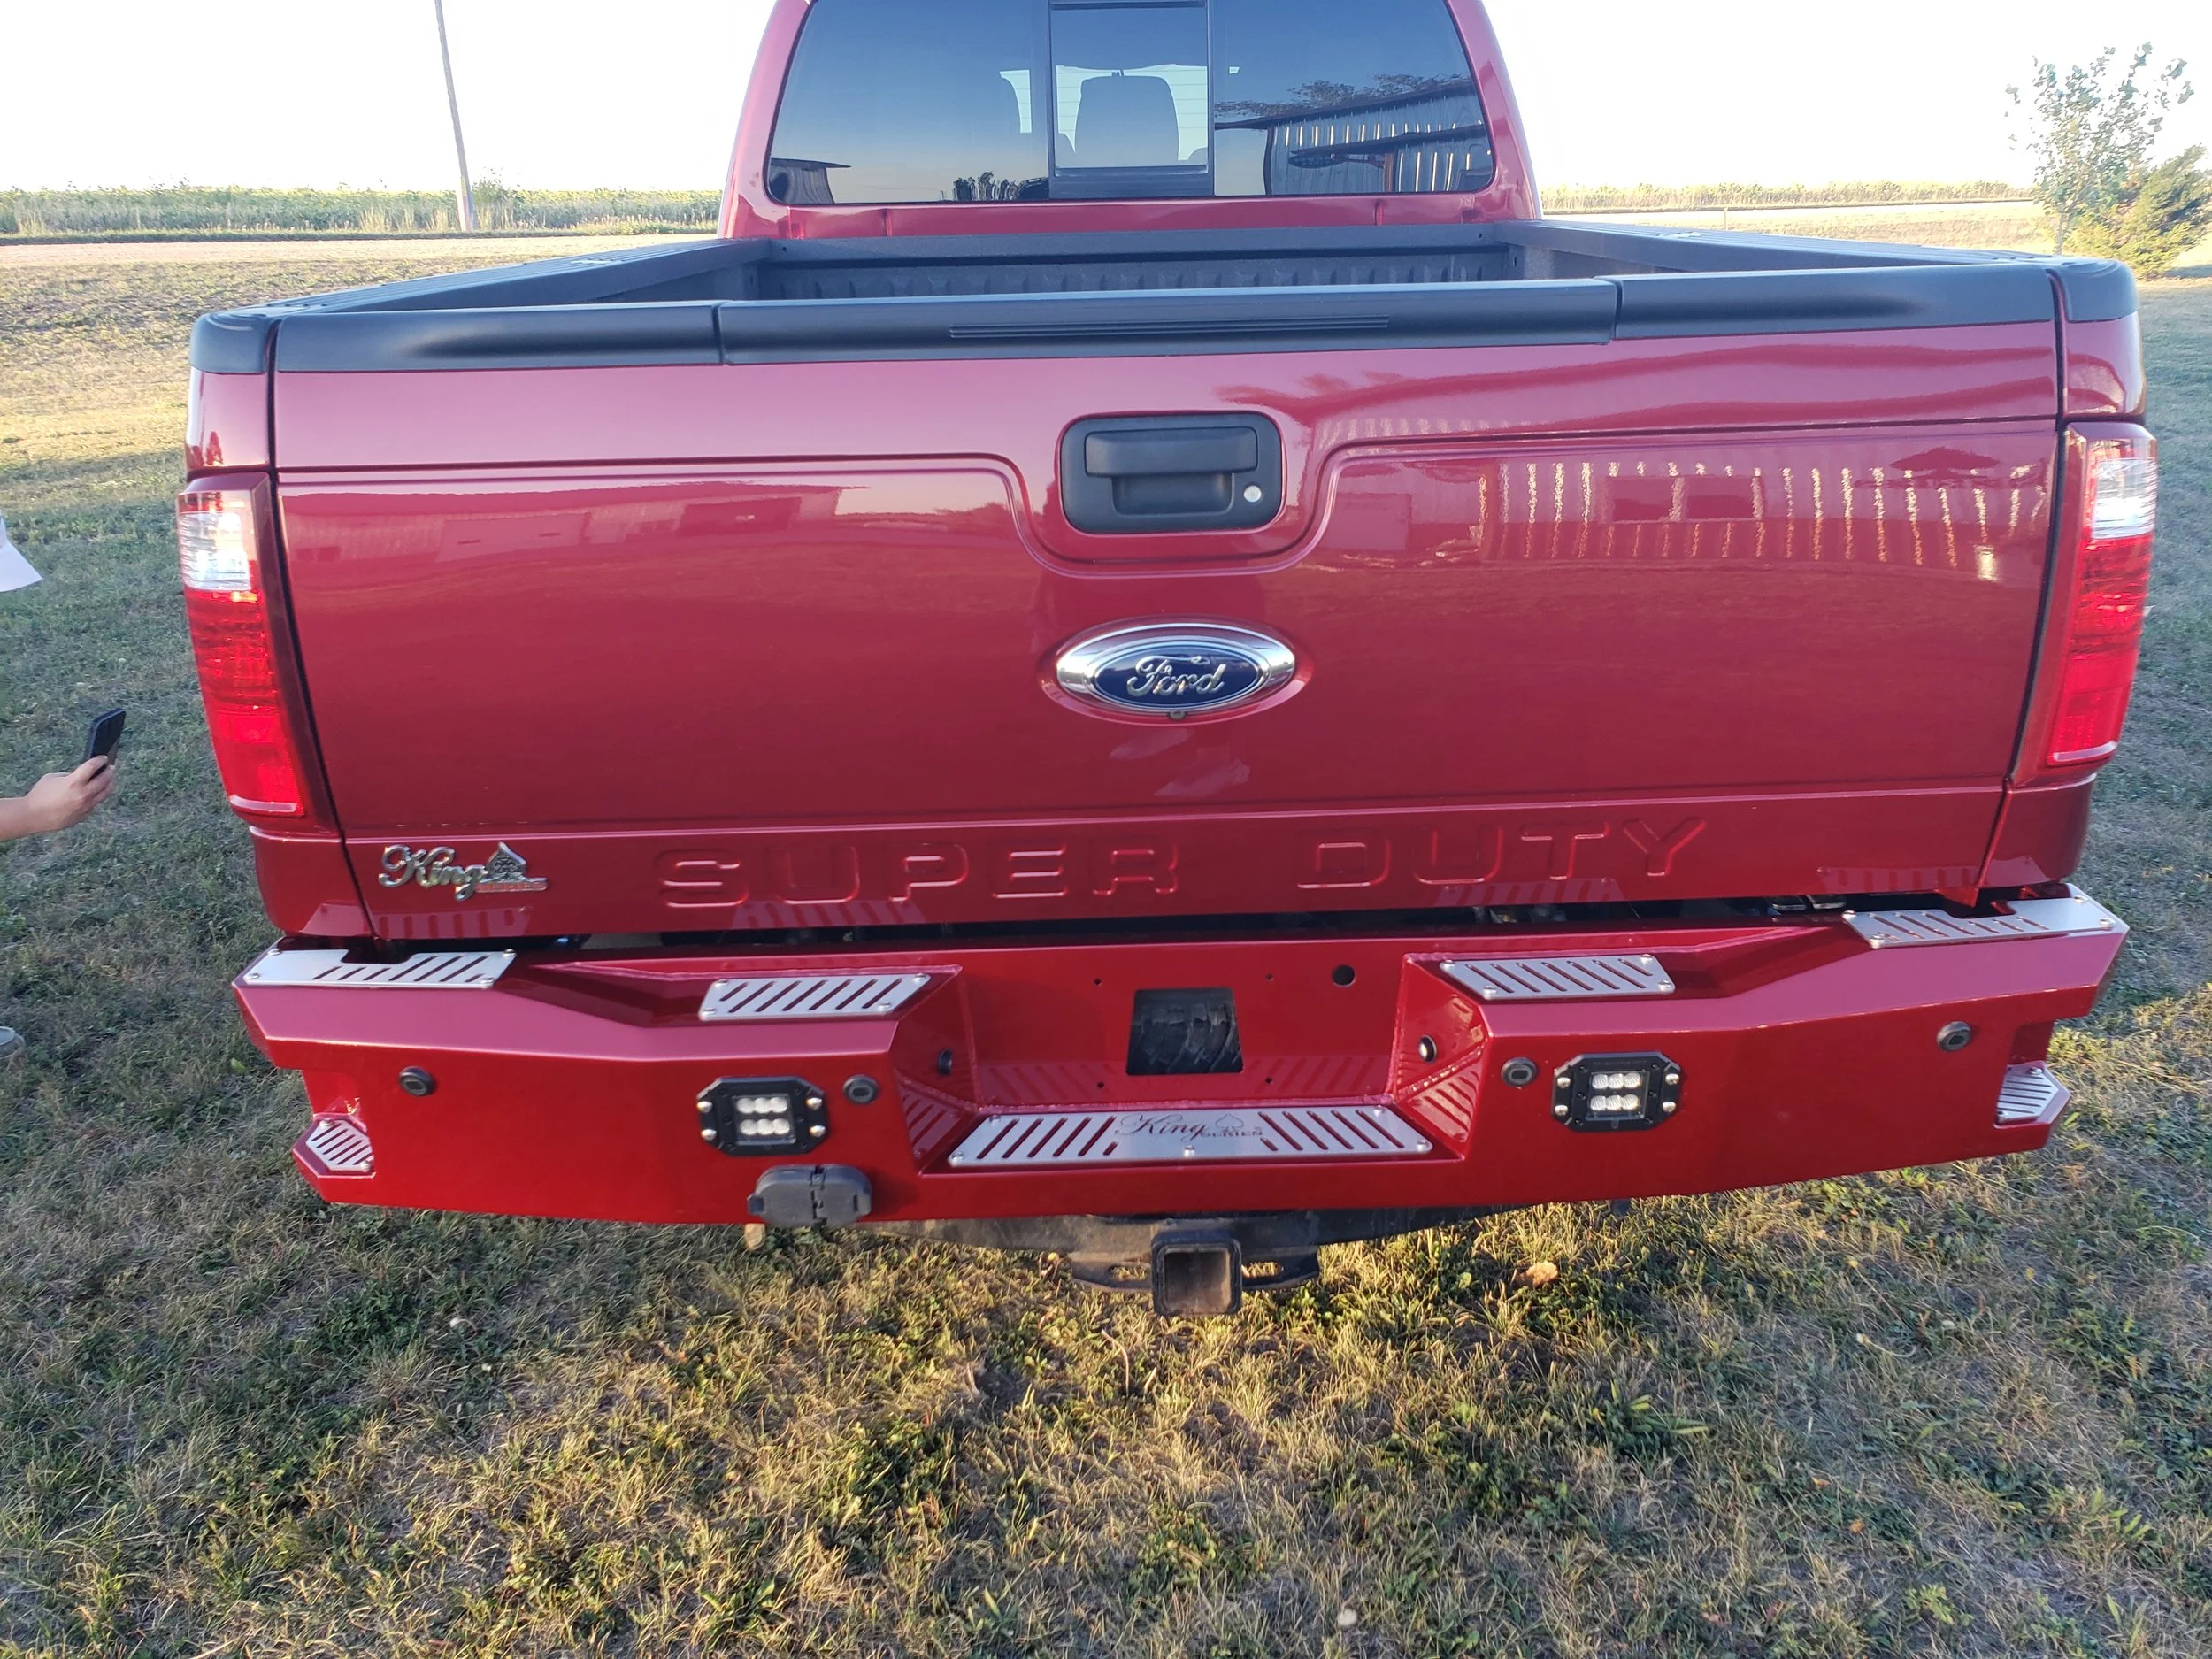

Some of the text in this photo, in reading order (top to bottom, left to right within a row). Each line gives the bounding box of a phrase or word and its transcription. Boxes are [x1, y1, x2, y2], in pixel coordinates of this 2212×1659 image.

[1126, 655, 1227, 697] Ford
[378, 843, 488, 901] King
[654, 818, 1708, 908] SUPER DUTY
[1115, 1113, 1206, 1142] King
